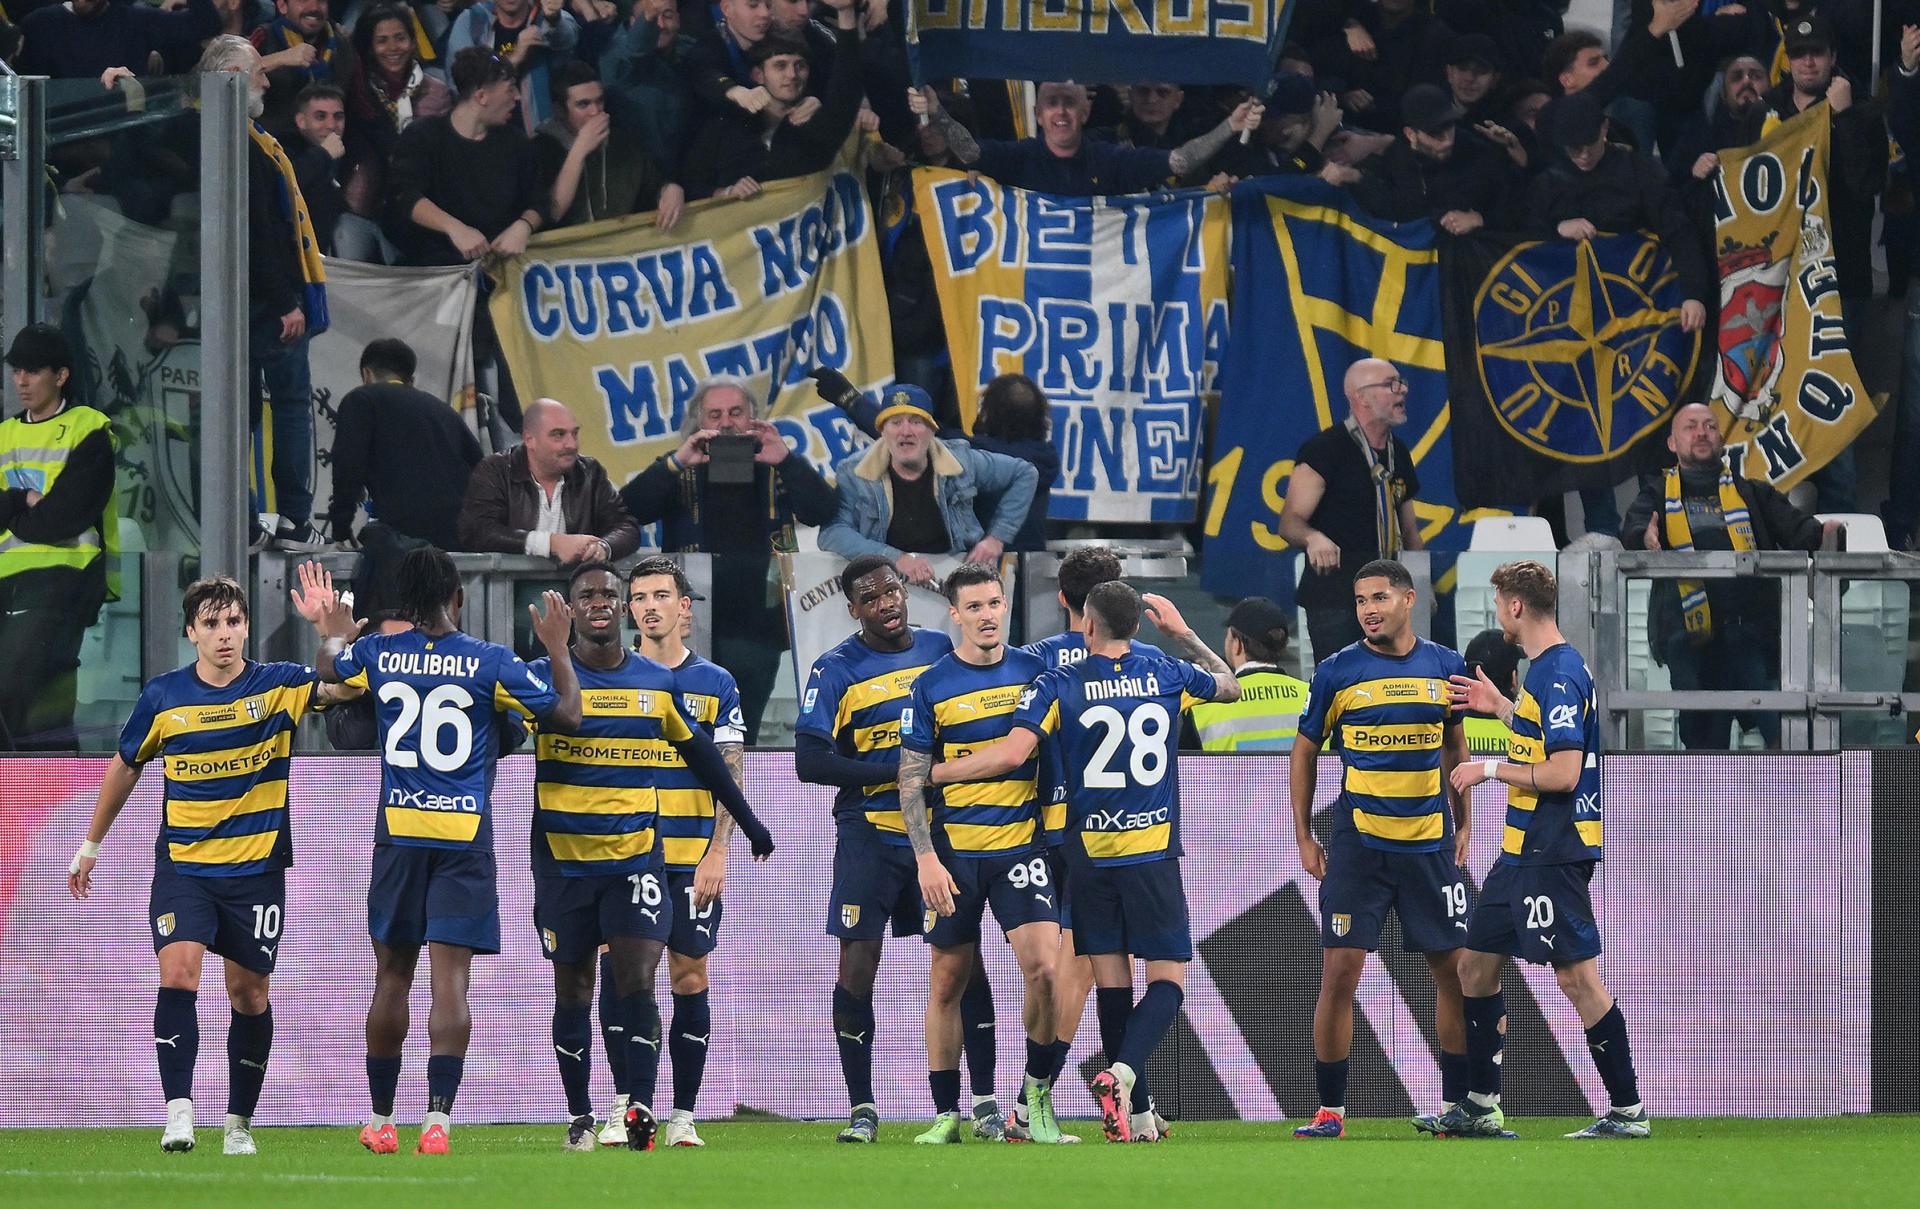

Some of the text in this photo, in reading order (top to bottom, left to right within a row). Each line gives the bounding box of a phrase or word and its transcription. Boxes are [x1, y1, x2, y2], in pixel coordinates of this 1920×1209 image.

[522, 240, 740, 342] CURVA
[977, 294, 1230, 398] PRIMA
[378, 652, 480, 679] COULIBALY
[979, 692, 1018, 703] ADMIRAL
[1084, 672, 1160, 701] MIHĂILĂ
[1240, 685, 1299, 703] UVENTUS
[196, 706, 239, 718] ADMIRAL
[378, 681, 474, 772] 26
[174, 743, 278, 777] PROMETEON
[550, 738, 658, 761] PROMETEON
[1078, 703, 1171, 789] 28
[627, 873, 662, 906] 16
[1007, 858, 1050, 889] 98
[1442, 882, 1468, 918] 19
[1523, 895, 1556, 930] 20
[252, 904, 281, 940] 10
